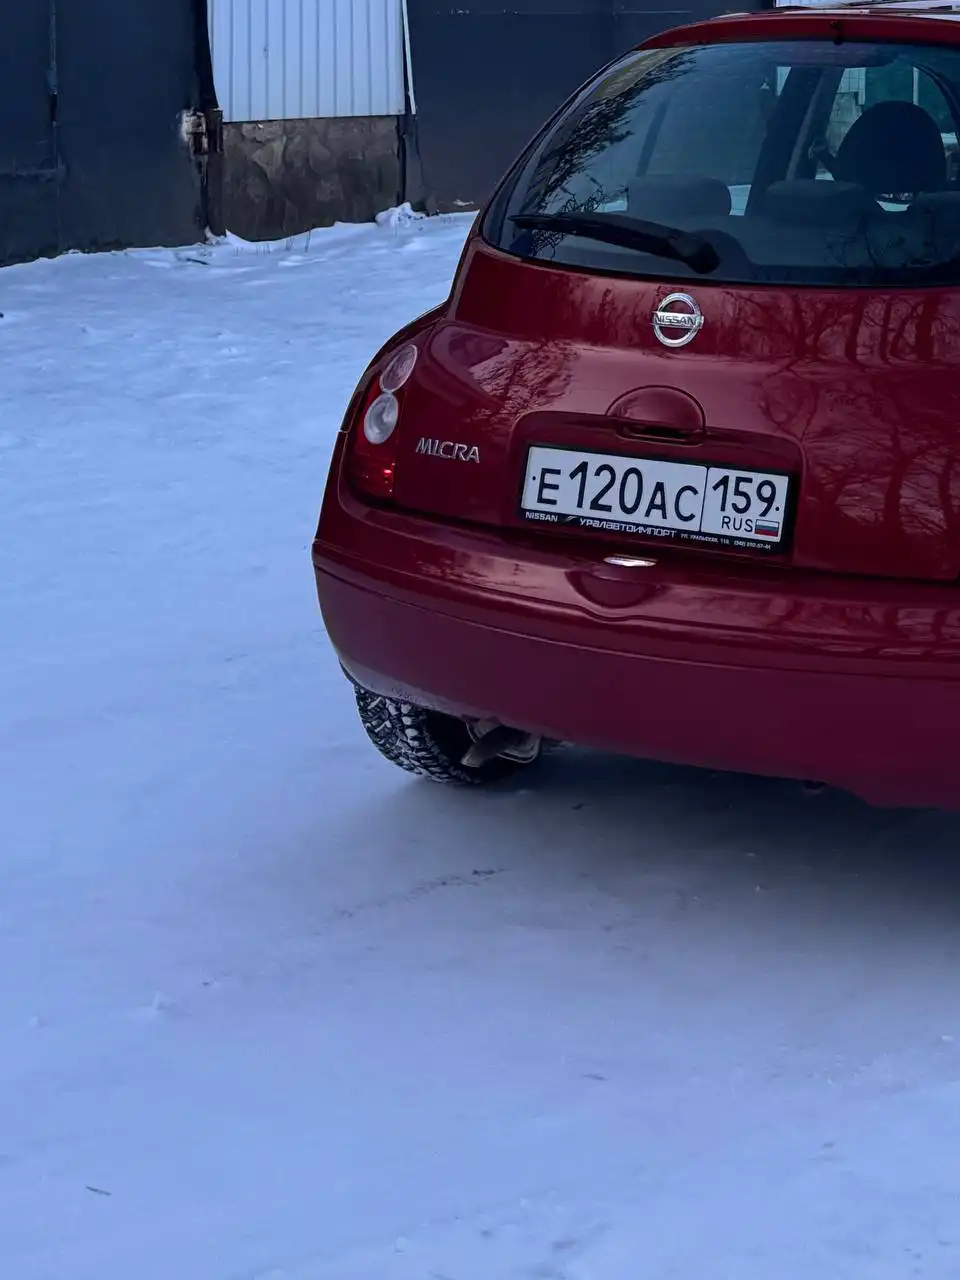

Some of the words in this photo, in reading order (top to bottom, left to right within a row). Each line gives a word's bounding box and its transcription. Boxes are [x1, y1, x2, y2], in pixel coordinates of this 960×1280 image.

[654, 312, 698, 326] NISSAN
[415, 437, 480, 463] MICRA
[712, 475, 777, 517] 159
[525, 511, 558, 523] NISSAN
[721, 515, 753, 533] RUS
